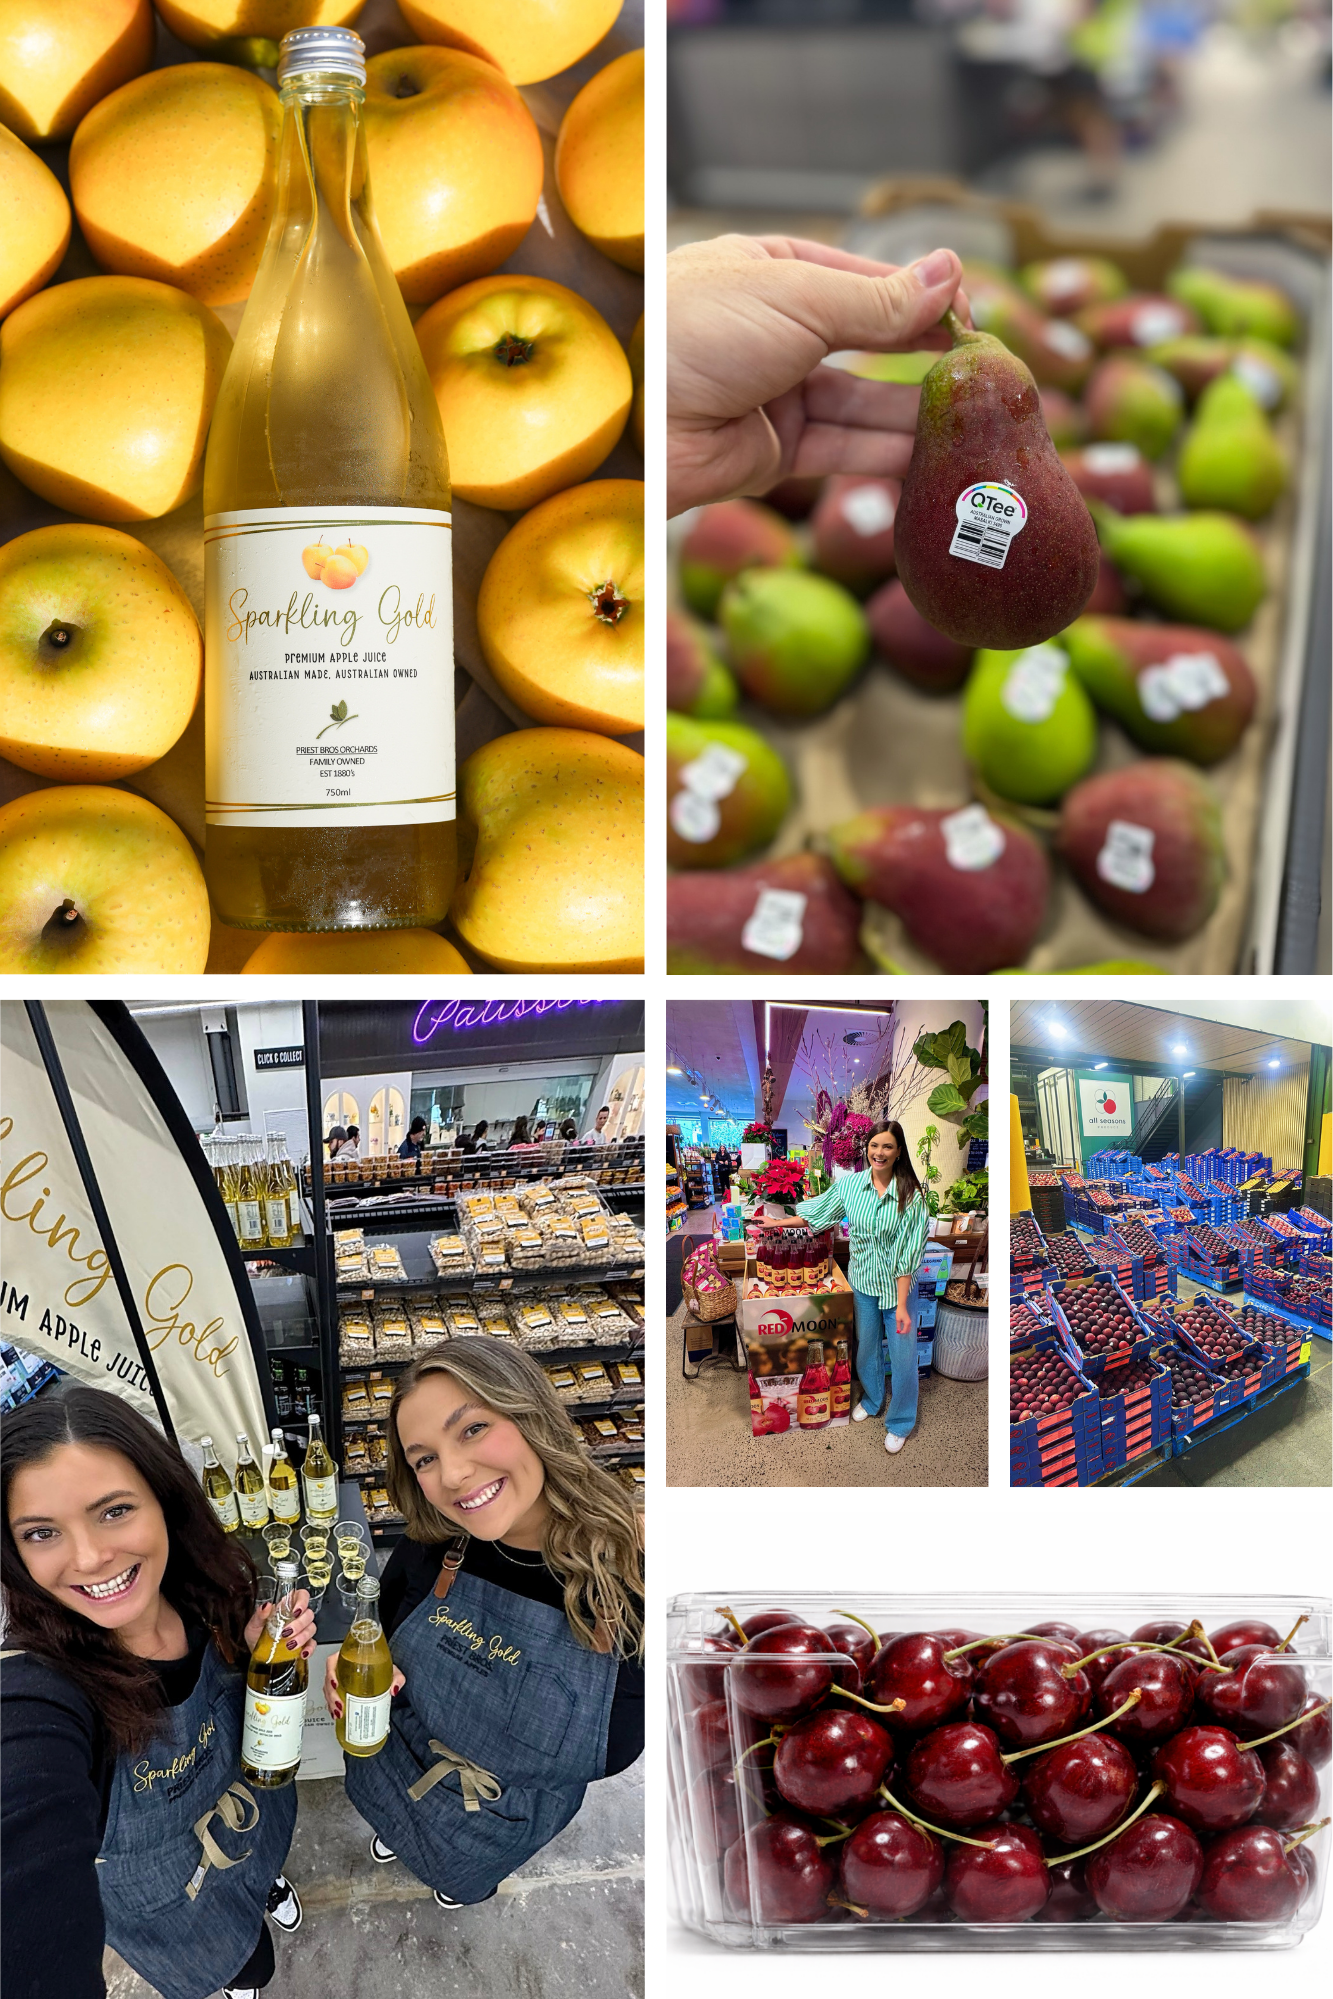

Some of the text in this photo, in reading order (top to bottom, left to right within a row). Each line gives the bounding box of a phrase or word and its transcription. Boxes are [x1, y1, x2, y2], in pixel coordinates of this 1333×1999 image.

[971, 492, 1015, 517] QTee
[226, 585, 437, 646] Sparkling Gold
[329, 651, 359, 664] APPLE
[362, 651, 387, 663] JUICE
[249, 670, 300, 681] AUSTRALIAN
[335, 669, 389, 680] AUSTRALIAN
[393, 668, 418, 679] OWNED
[296, 745, 378, 755] PRIEST BROS ORCHARDS
[309, 757, 366, 766] FAMILY OWNED
[319, 768, 356, 778] EST 1880's
[325, 787, 352, 797] 750ml
[257, 1053, 273, 1065] CLICK
[279, 1050, 303, 1063] COLLECT
[145, 1263, 239, 1378] Gold
[758, 1319, 837, 1335] RED MOON
[38, 1308, 101, 1362] APPLE
[428, 1605, 521, 1666] Sparkling Gold
[133, 1745, 197, 1792] Sparkling
